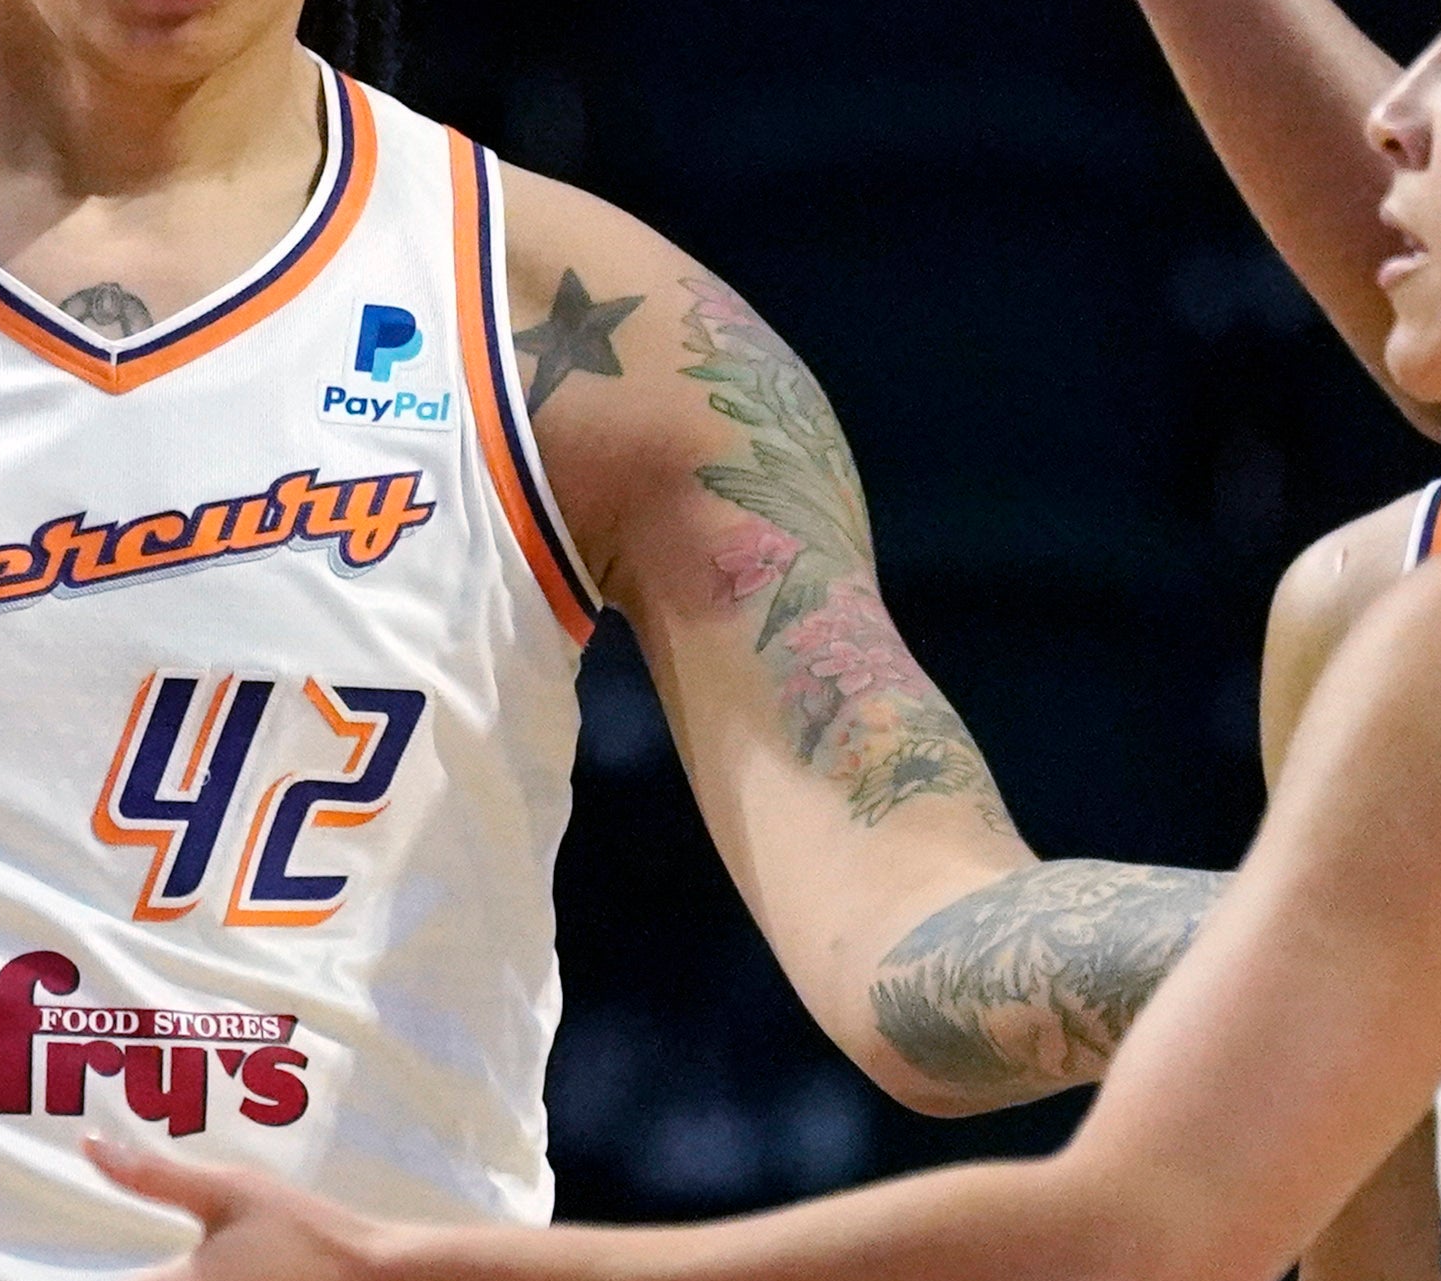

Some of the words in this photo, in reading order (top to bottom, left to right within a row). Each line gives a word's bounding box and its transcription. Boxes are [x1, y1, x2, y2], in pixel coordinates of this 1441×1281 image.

[323, 386, 451, 422] PayPal
[91, 670, 427, 927] 42
[39, 1006, 140, 1035] FOOD
[153, 1010, 281, 1040] STORES
